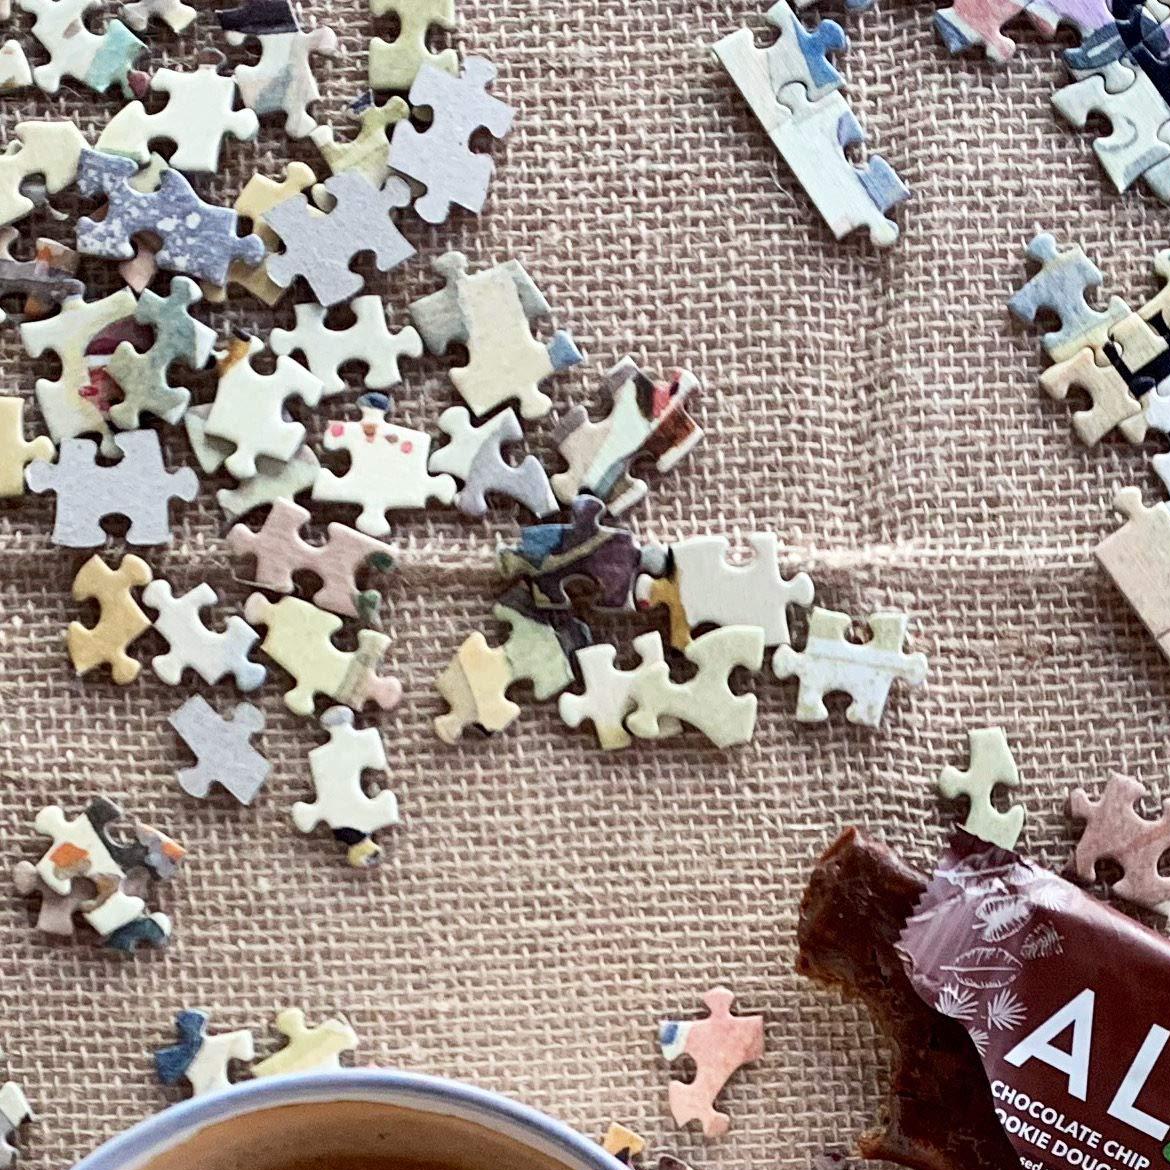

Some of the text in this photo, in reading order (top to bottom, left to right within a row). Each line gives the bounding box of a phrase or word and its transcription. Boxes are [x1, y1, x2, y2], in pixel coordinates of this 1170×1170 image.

[990, 1080, 1151, 1170] CHOCOLATE CHIP
[994, 1108, 1052, 1150] OOKIE
